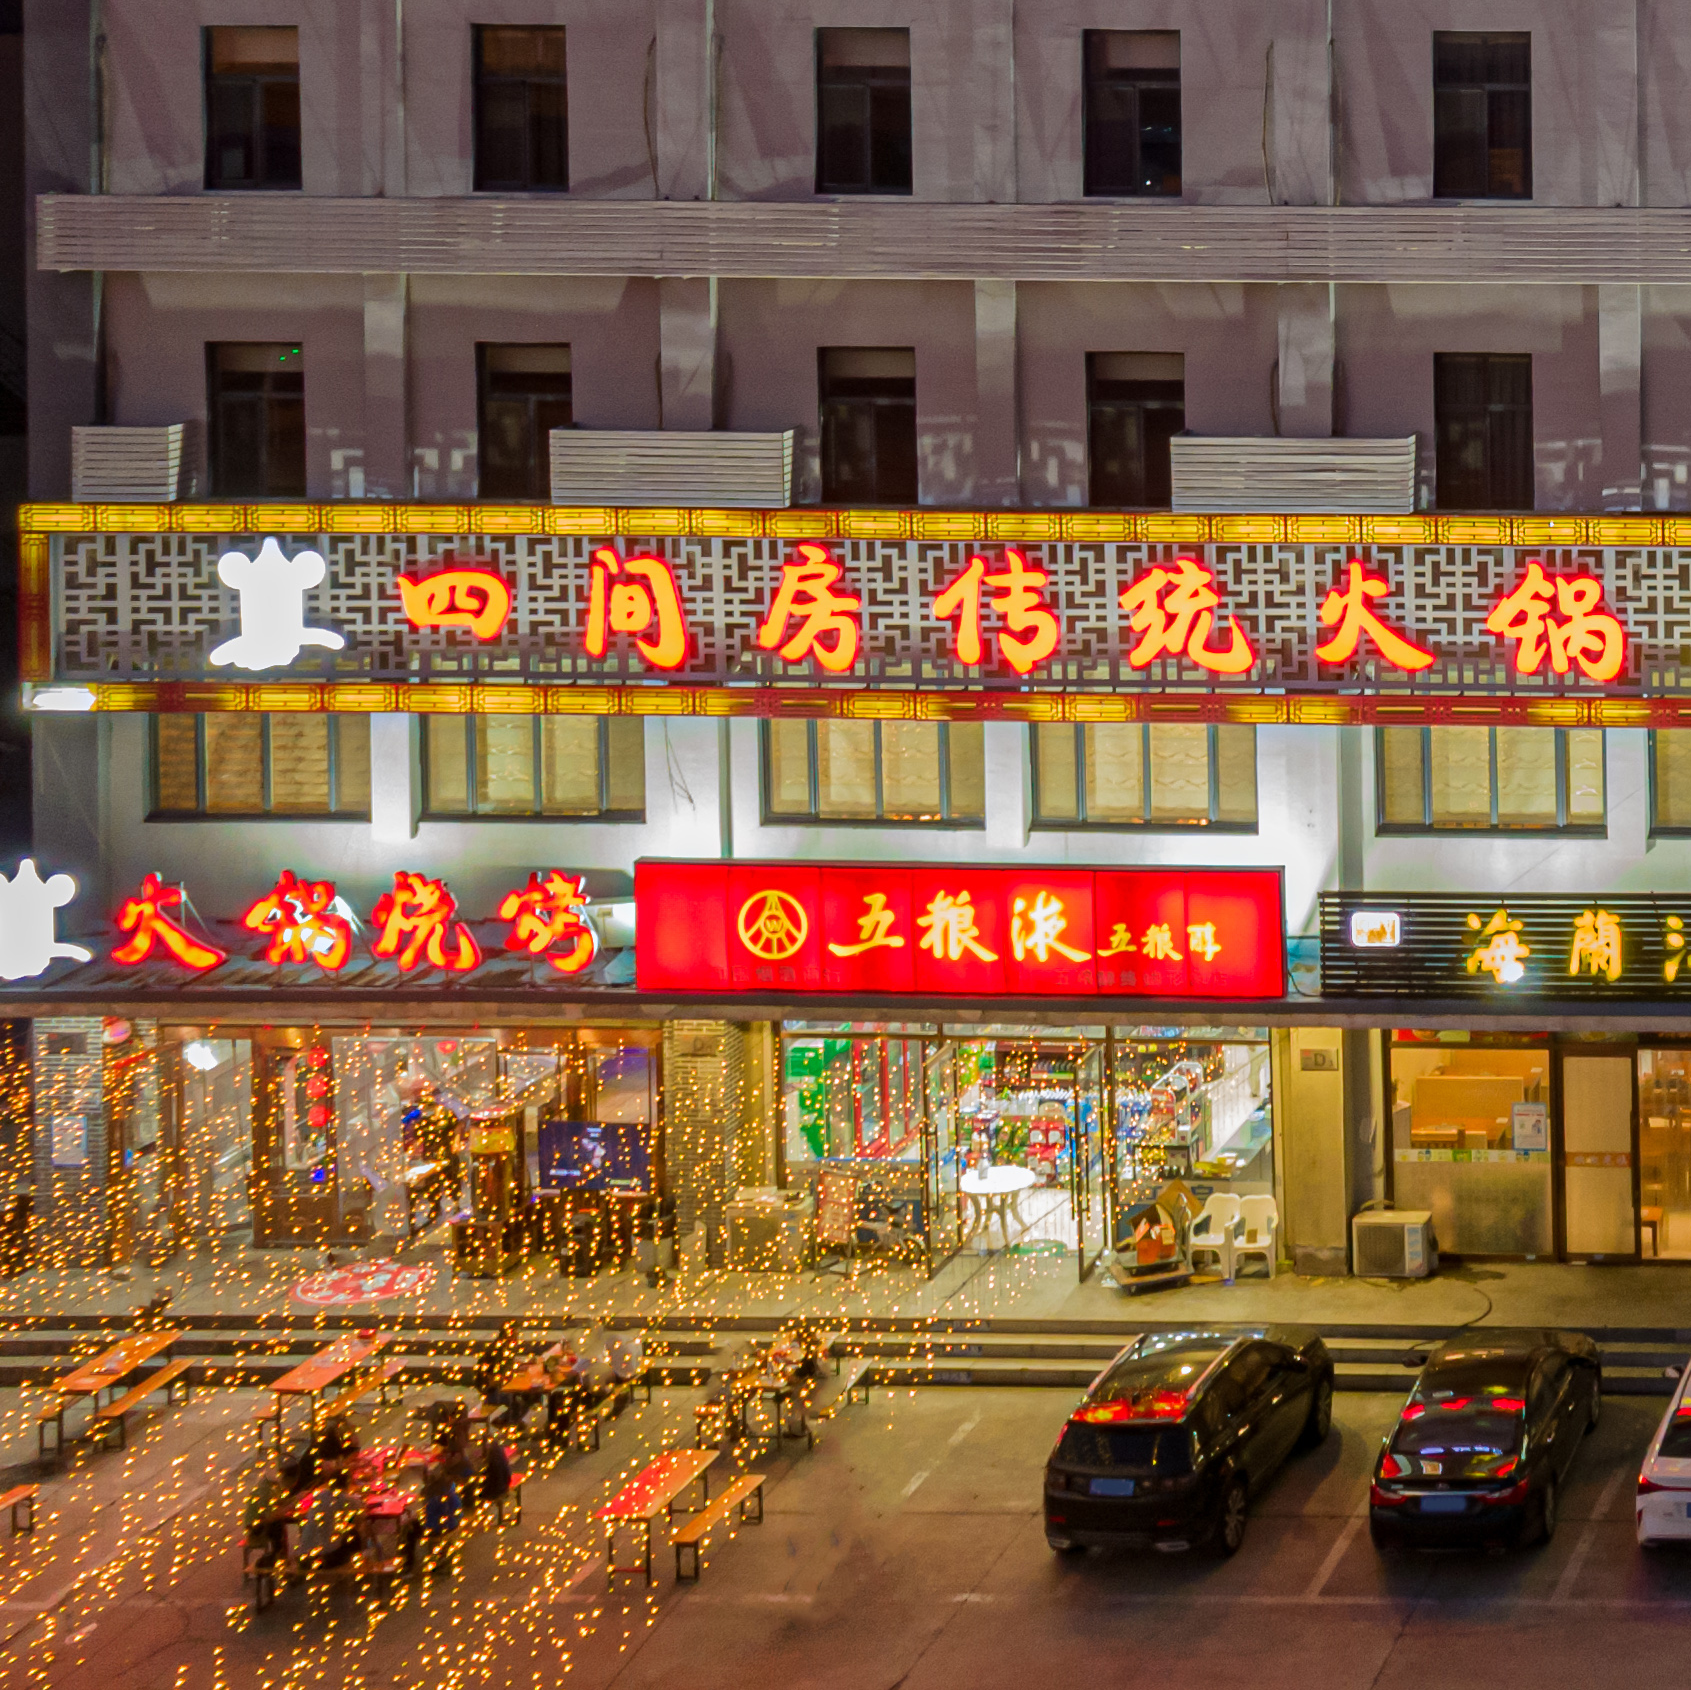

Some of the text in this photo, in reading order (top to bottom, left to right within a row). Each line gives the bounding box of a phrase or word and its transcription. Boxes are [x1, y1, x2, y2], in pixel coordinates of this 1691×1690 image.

[396, 541, 1629, 681] 四间房传统火锅
[110, 869, 600, 974] 火锅烧烤
[827, 888, 1093, 963] 五粮液
